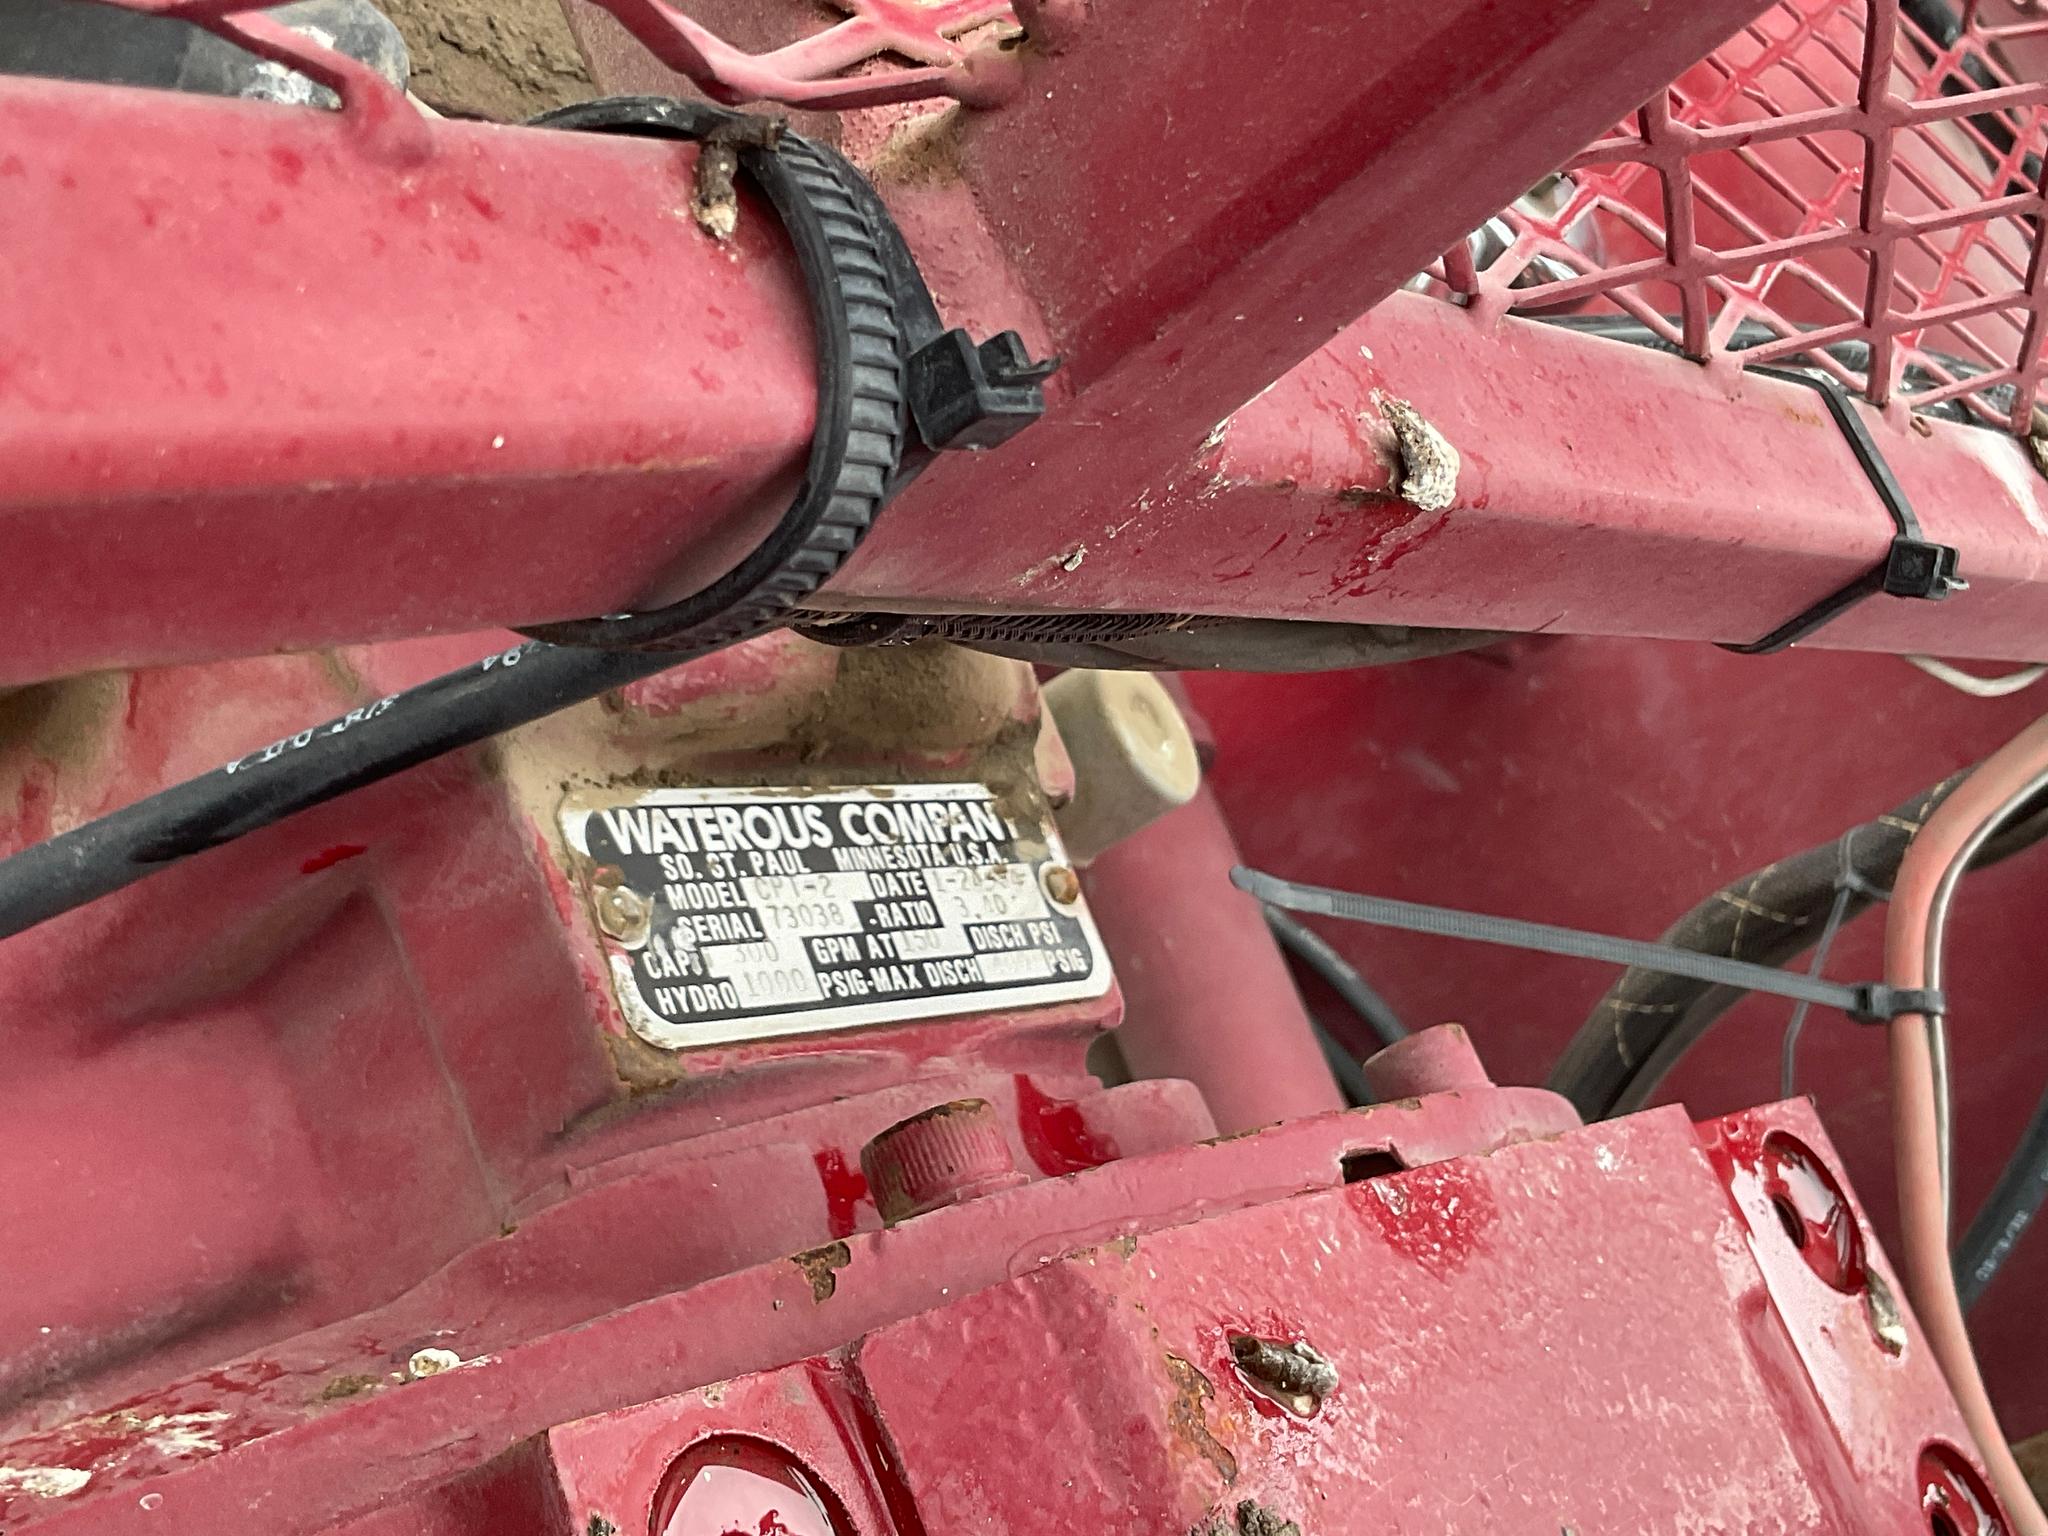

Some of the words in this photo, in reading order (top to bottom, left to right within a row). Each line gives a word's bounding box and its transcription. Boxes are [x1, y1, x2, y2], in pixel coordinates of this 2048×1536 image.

[602, 803, 834, 855] WATEROUS
[839, 801, 1019, 846] COMPAN
[659, 853, 704, 881] SO.
[706, 852, 748, 880] ST.
[748, 849, 812, 877] PAUL
[832, 843, 947, 872] MINNESOTA
[949, 841, 1009, 866] U.S.A.
[664, 880, 748, 911] MODEL
[868, 871, 929, 900] DATE
[675, 911, 765, 945] SERIAL
[765, 901, 845, 930] 73038
[811, 935, 863, 965] GPM
[864, 929, 901, 961] AT
[968, 921, 1027, 951] DISCH
[1029, 919, 1063, 946] PSI
[655, 980, 742, 1016] HYDRO
[922, 955, 984, 988] DISCH
[1043, 947, 1089, 975] PSIG
